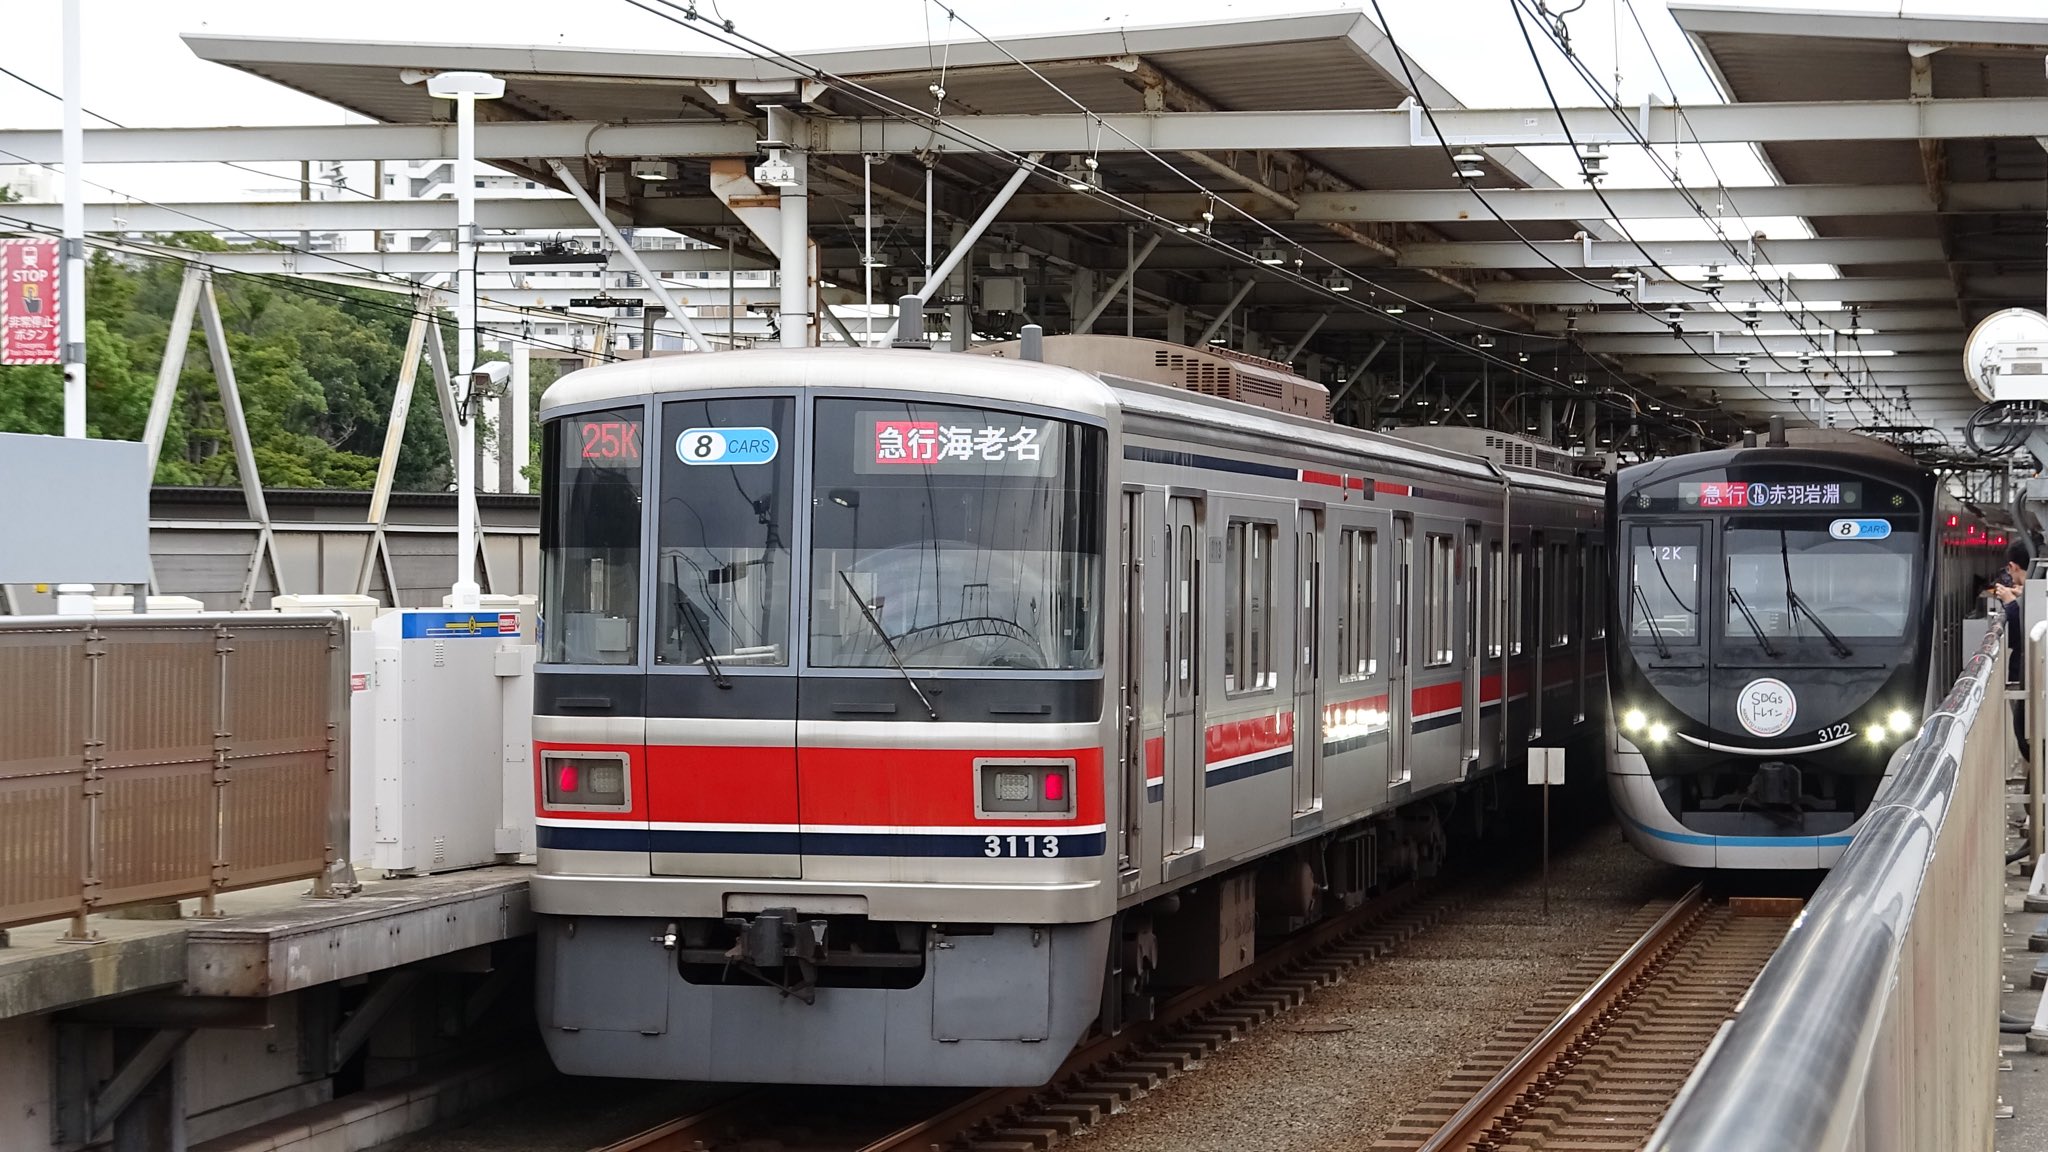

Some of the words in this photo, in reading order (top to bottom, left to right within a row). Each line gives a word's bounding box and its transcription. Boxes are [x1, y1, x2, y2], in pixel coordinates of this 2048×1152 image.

[12, 269, 49, 282] STOP
[8, 315, 54, 328] 非常停止
[14, 328, 49, 341] ボタン
[582, 423, 639, 458] 25K
[694, 434, 713, 458] 8
[728, 439, 771, 454] CARS
[878, 426, 937, 459] 急行
[937, 425, 1040, 461] 海老名
[1703, 484, 1745, 504] 急行
[1754, 485, 1762, 495] N
[1769, 484, 1840, 504] 赤羽岩淵
[1840, 523, 1851, 535] 8
[1860, 525, 1886, 534] CARS
[1652, 546, 1682, 560] 12K
[1751, 691, 1783, 706] SDGs
[1753, 705, 1782, 721] トレイン
[1818, 723, 1852, 742] 3122
[984, 835, 1059, 858] 3113
